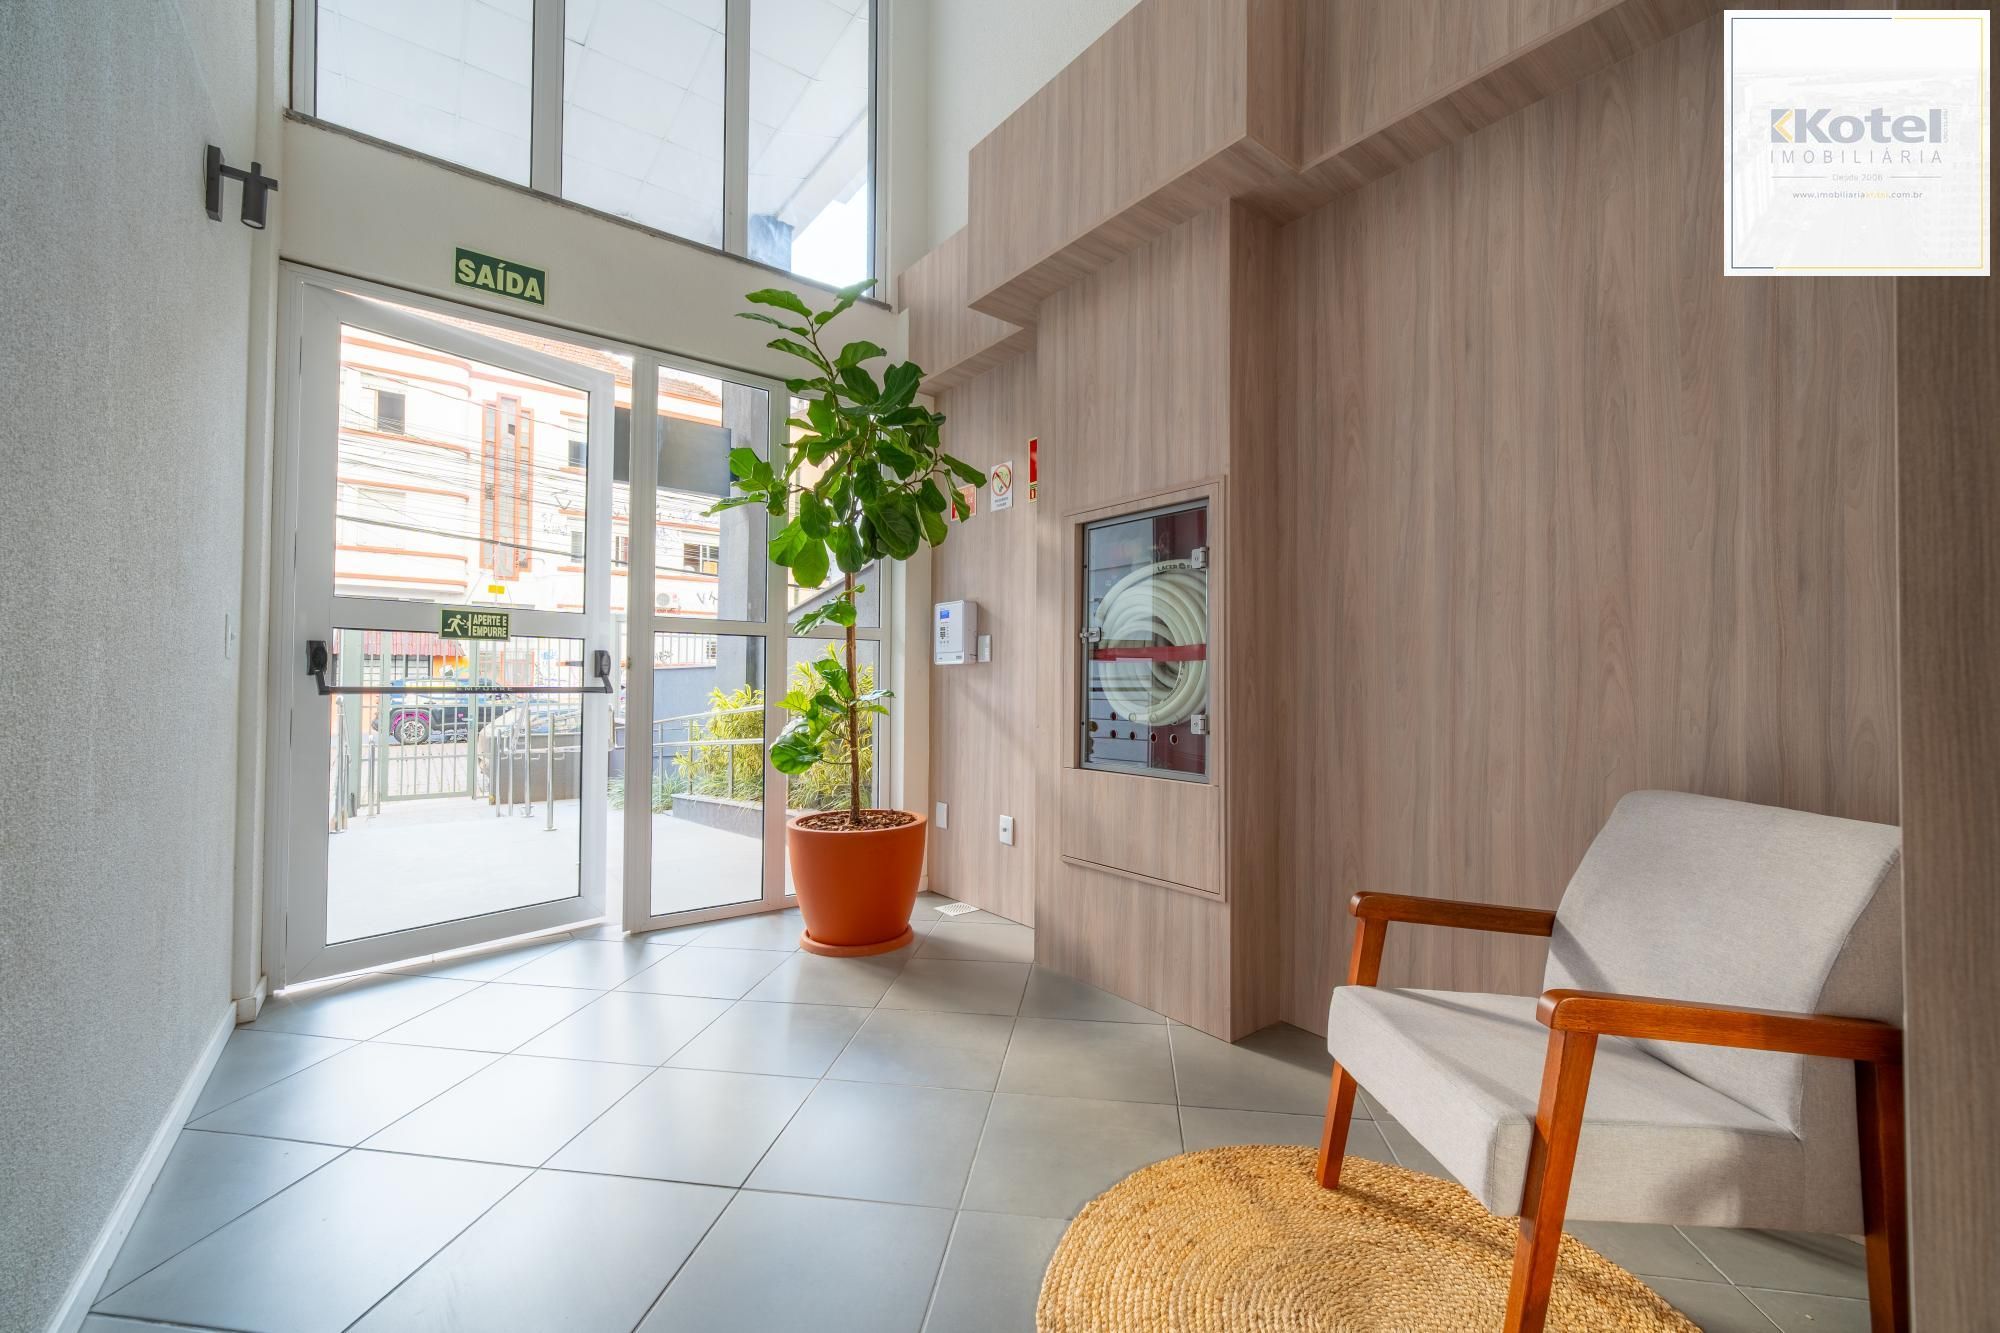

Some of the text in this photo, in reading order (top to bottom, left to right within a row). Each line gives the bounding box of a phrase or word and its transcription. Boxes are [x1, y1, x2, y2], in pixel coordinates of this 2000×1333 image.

[457, 258, 542, 301] SAÍDA
[472, 614, 507, 626] APERTE E
[472, 626, 507, 637] EMPURRE
